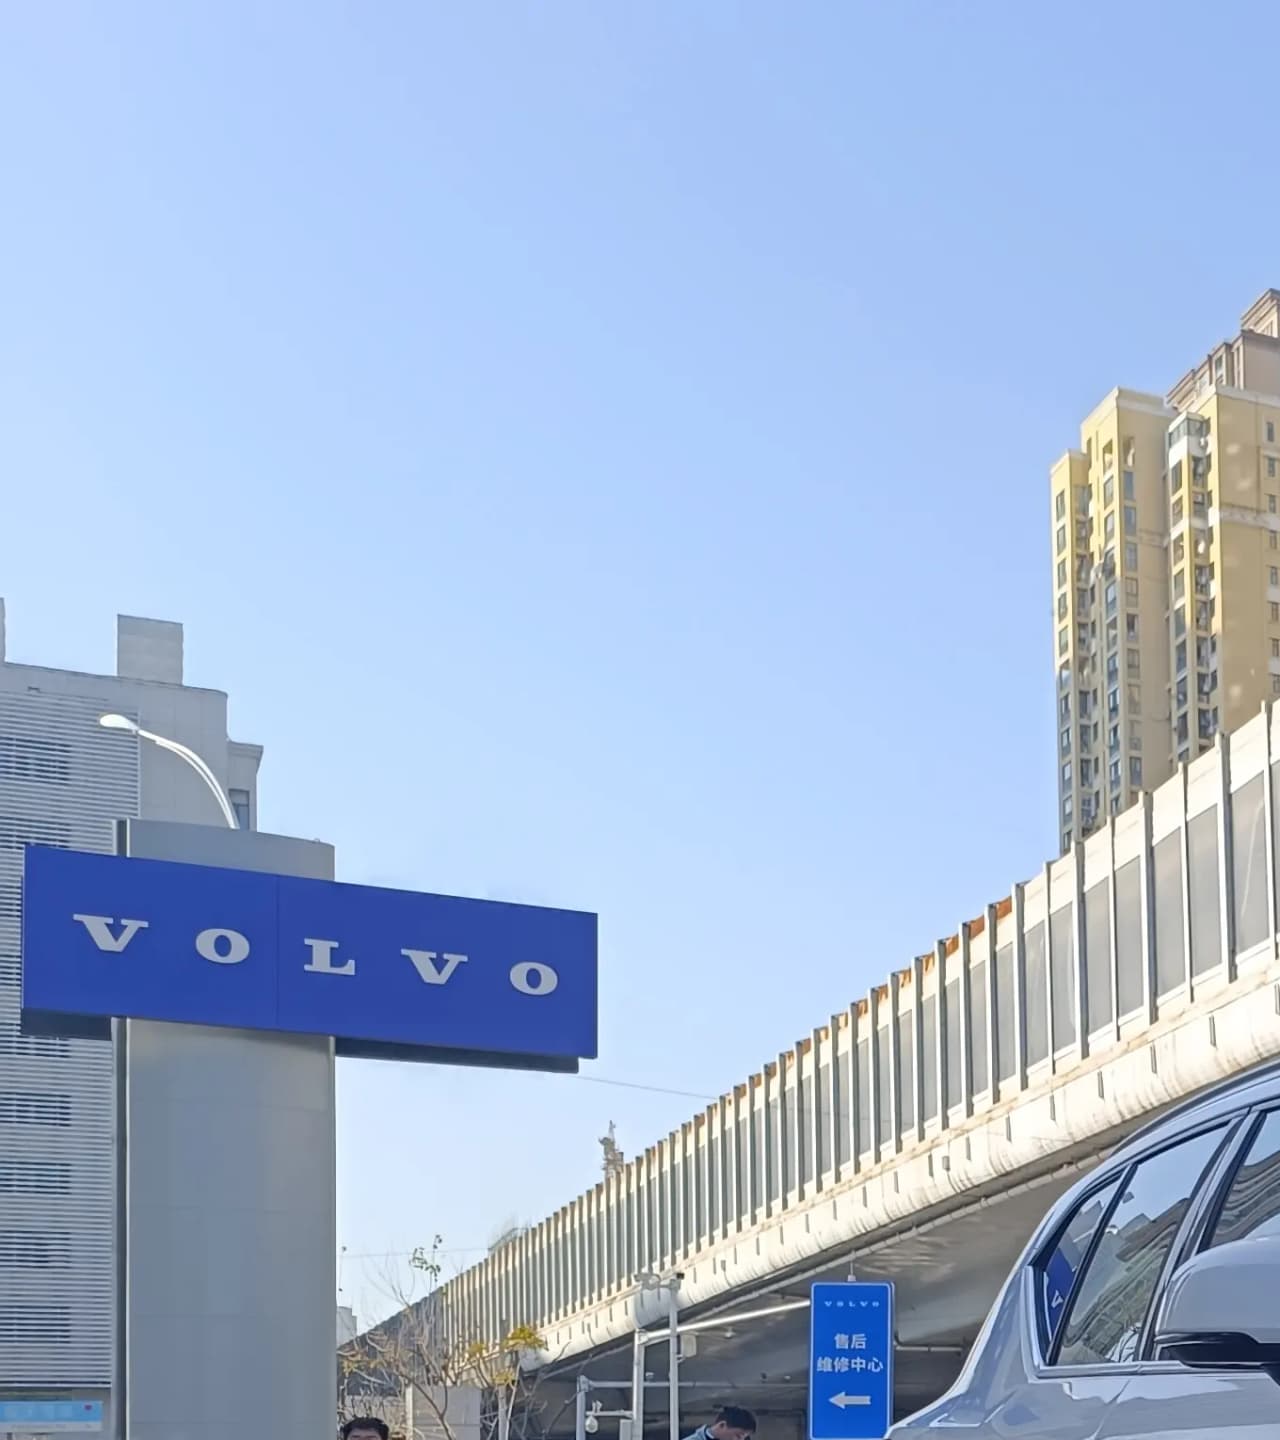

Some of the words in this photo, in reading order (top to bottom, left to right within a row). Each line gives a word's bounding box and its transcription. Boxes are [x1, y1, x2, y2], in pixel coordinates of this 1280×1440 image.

[73, 913, 559, 996] VOLVO
[824, 1300, 880, 1308] VOLVO
[834, 1333, 867, 1350] 售后
[816, 1356, 884, 1373] 维修中心
